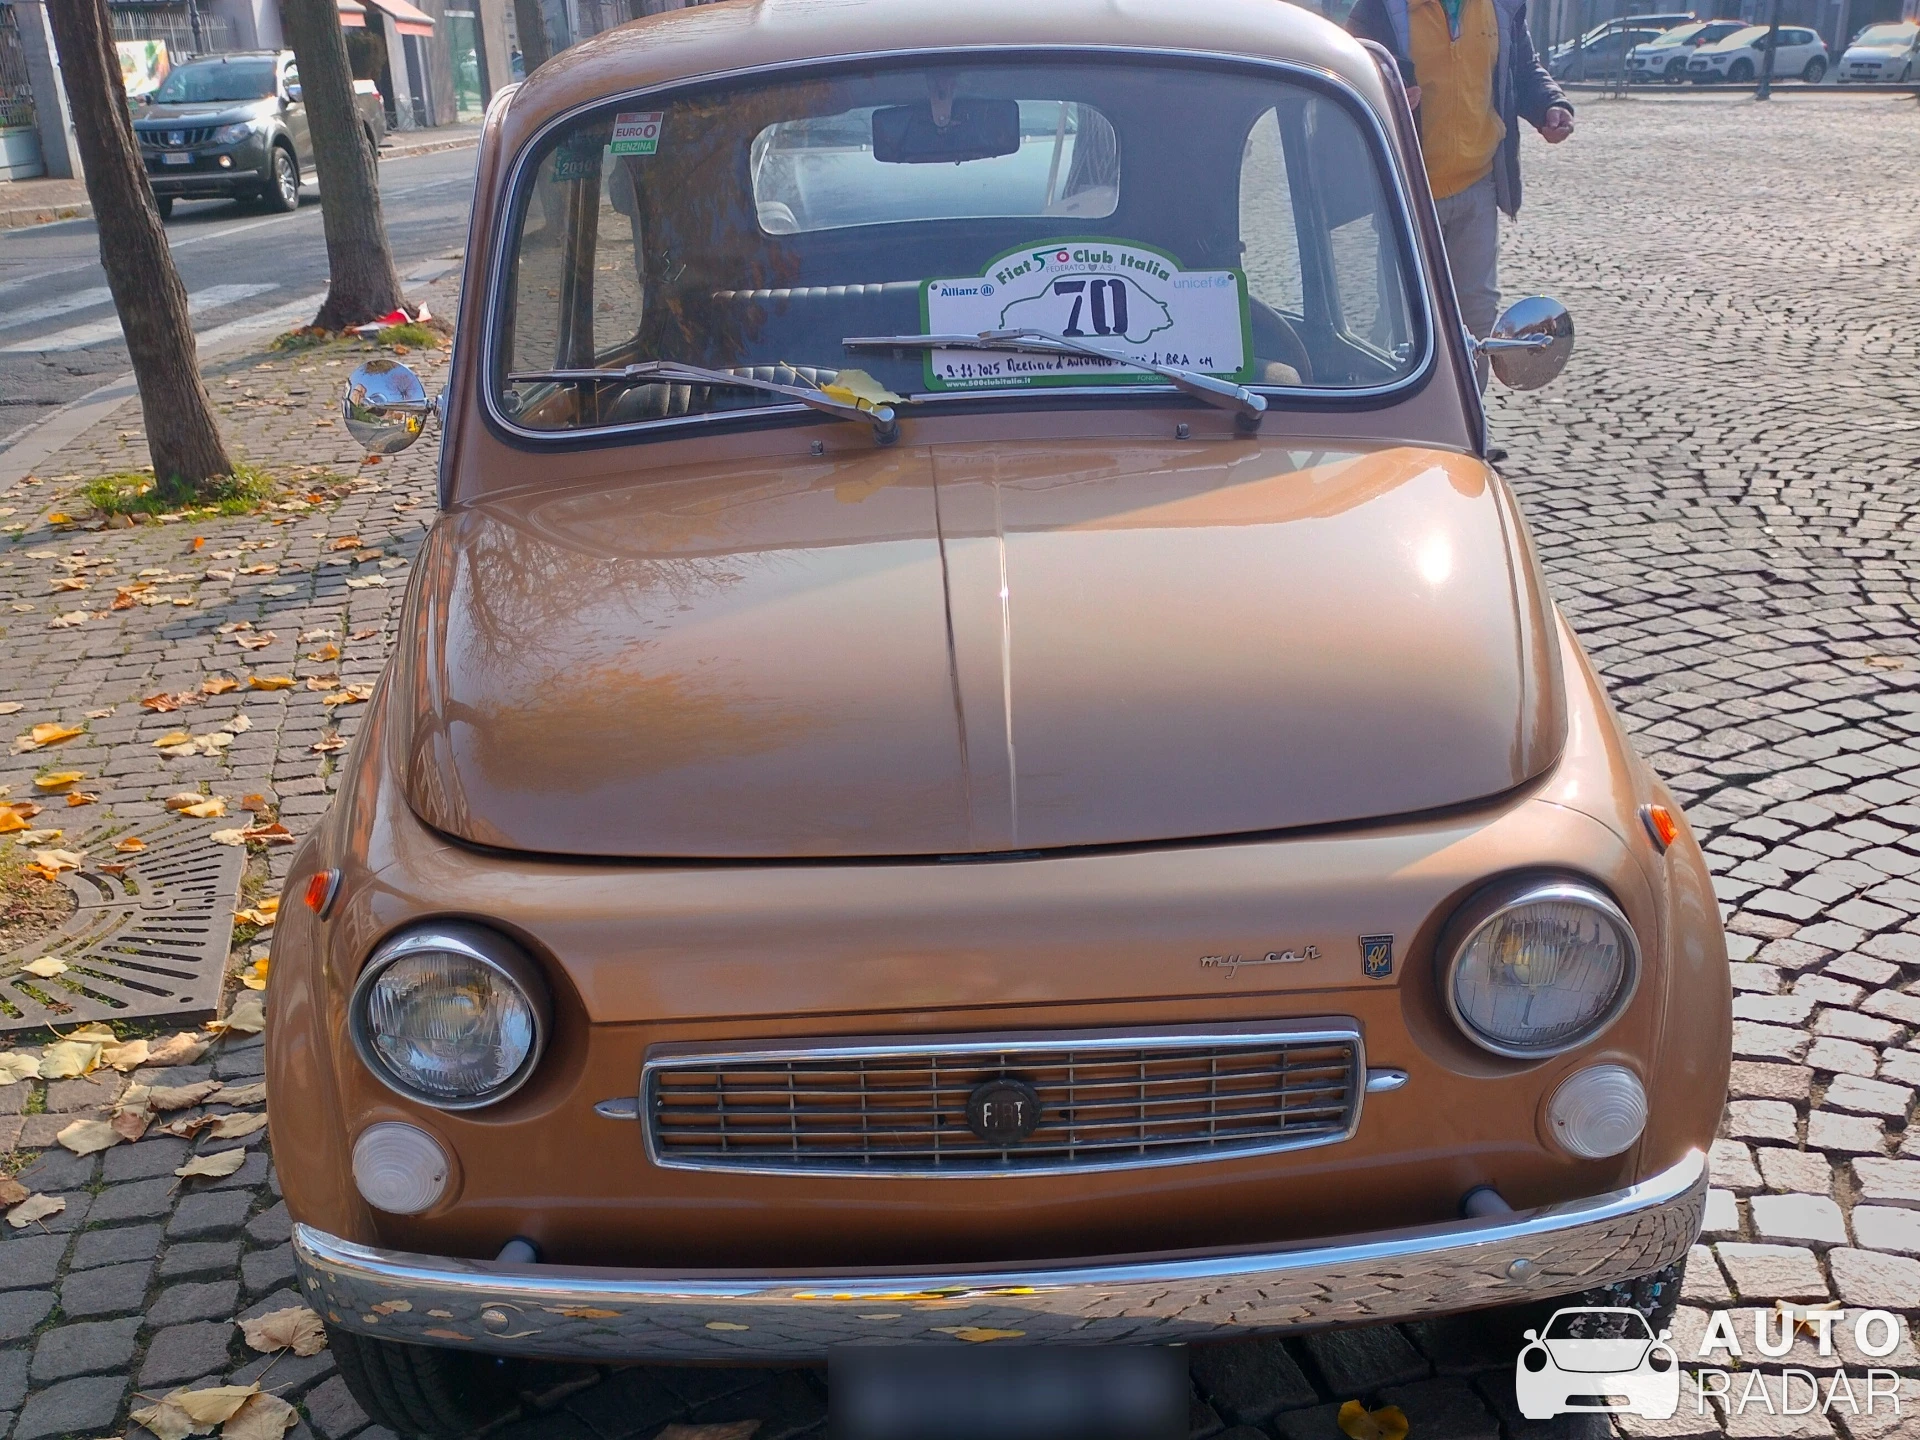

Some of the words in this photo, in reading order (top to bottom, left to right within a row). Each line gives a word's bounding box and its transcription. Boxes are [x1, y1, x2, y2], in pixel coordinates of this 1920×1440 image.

[616, 127, 643, 137] EURO
[615, 141, 652, 152] BENZINA
[996, 260, 1031, 285] Fiat
[1073, 249, 1113, 264] Club
[1120, 253, 1170, 282] Italia
[1046, 264, 1085, 273] FEDERATO
[1173, 276, 1212, 289] unicef
[941, 287, 978, 297] Allianz
[1054, 279, 1128, 336] 70
[1166, 352, 1190, 365] BRA
[946, 377, 1031, 388] www.500clubitalia.it
